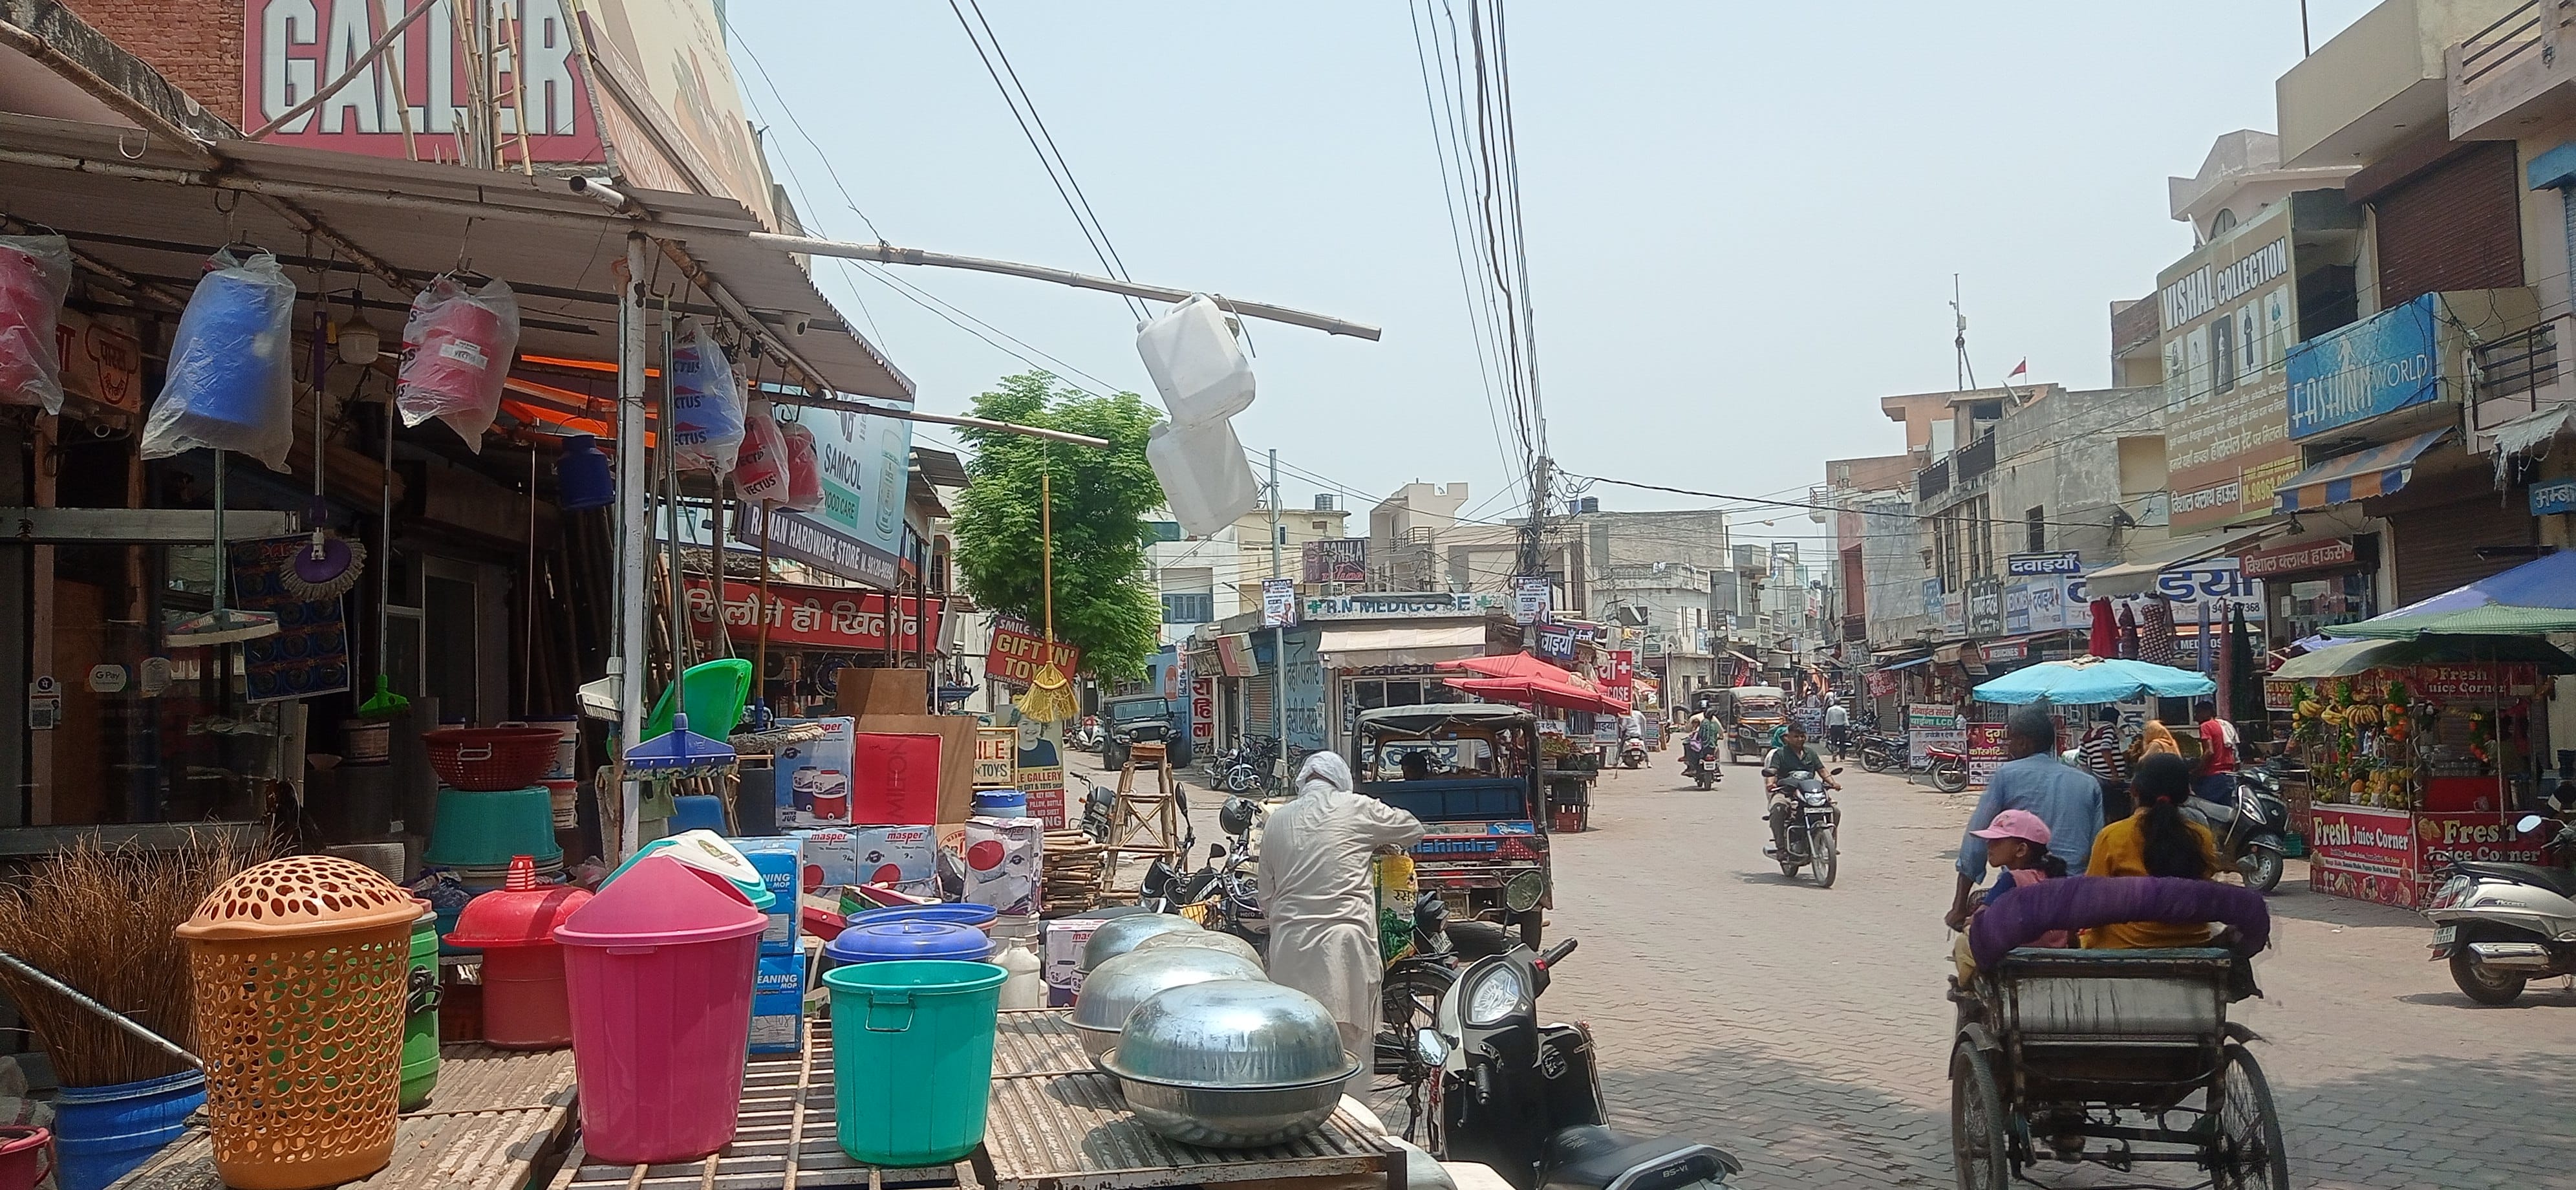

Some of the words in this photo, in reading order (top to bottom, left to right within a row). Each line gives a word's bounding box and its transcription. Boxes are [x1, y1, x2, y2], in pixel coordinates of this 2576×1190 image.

[2162, 263, 2215, 332] VISHAL
[2216, 237, 2287, 305] COLLECTION
[2372, 354, 2427, 391] WORLD
[674, 395, 701, 409] CTUS
[674, 431, 707, 446] ECTUS
[824, 444, 861, 491] SAMCOL
[744, 475, 776, 496] VECTUS
[840, 493, 855, 520] CARE
[2171, 490, 2194, 515] विशाल
[2216, 482, 2238, 506] हाऊस
[788, 520, 837, 562] HARDWARE
[836, 538, 861, 569] STORE
[2010, 554, 2077, 572] दवाइयाँ
[2244, 554, 2277, 574] विशाल
[2277, 550, 2308, 568] क्लाथ
[2310, 545, 2345, 564] हाऊस
[791, 598, 823, 631] ही
[2211, 603, 2260, 614] 94647368
[999, 619, 1031, 636] SMILE
[996, 633, 1043, 661] GIFT
[105, 672, 120, 680] Pay
[1004, 656, 1042, 683] TOY
[2439, 667, 2487, 681] Fresh
[2427, 682, 2457, 693] uice
[1027, 772, 1062, 783] GALLERY
[810, 832, 848, 845] masper
[886, 831, 924, 844] masper
[2313, 815, 2351, 846] Fresh
[2352, 825, 2375, 847] Juice
[2376, 827, 2409, 851] Corner
[2476, 847, 2540, 862] Coner
[757, 974, 798, 984] EANING
[1662, 1164, 1688, 1178] BS-VI
